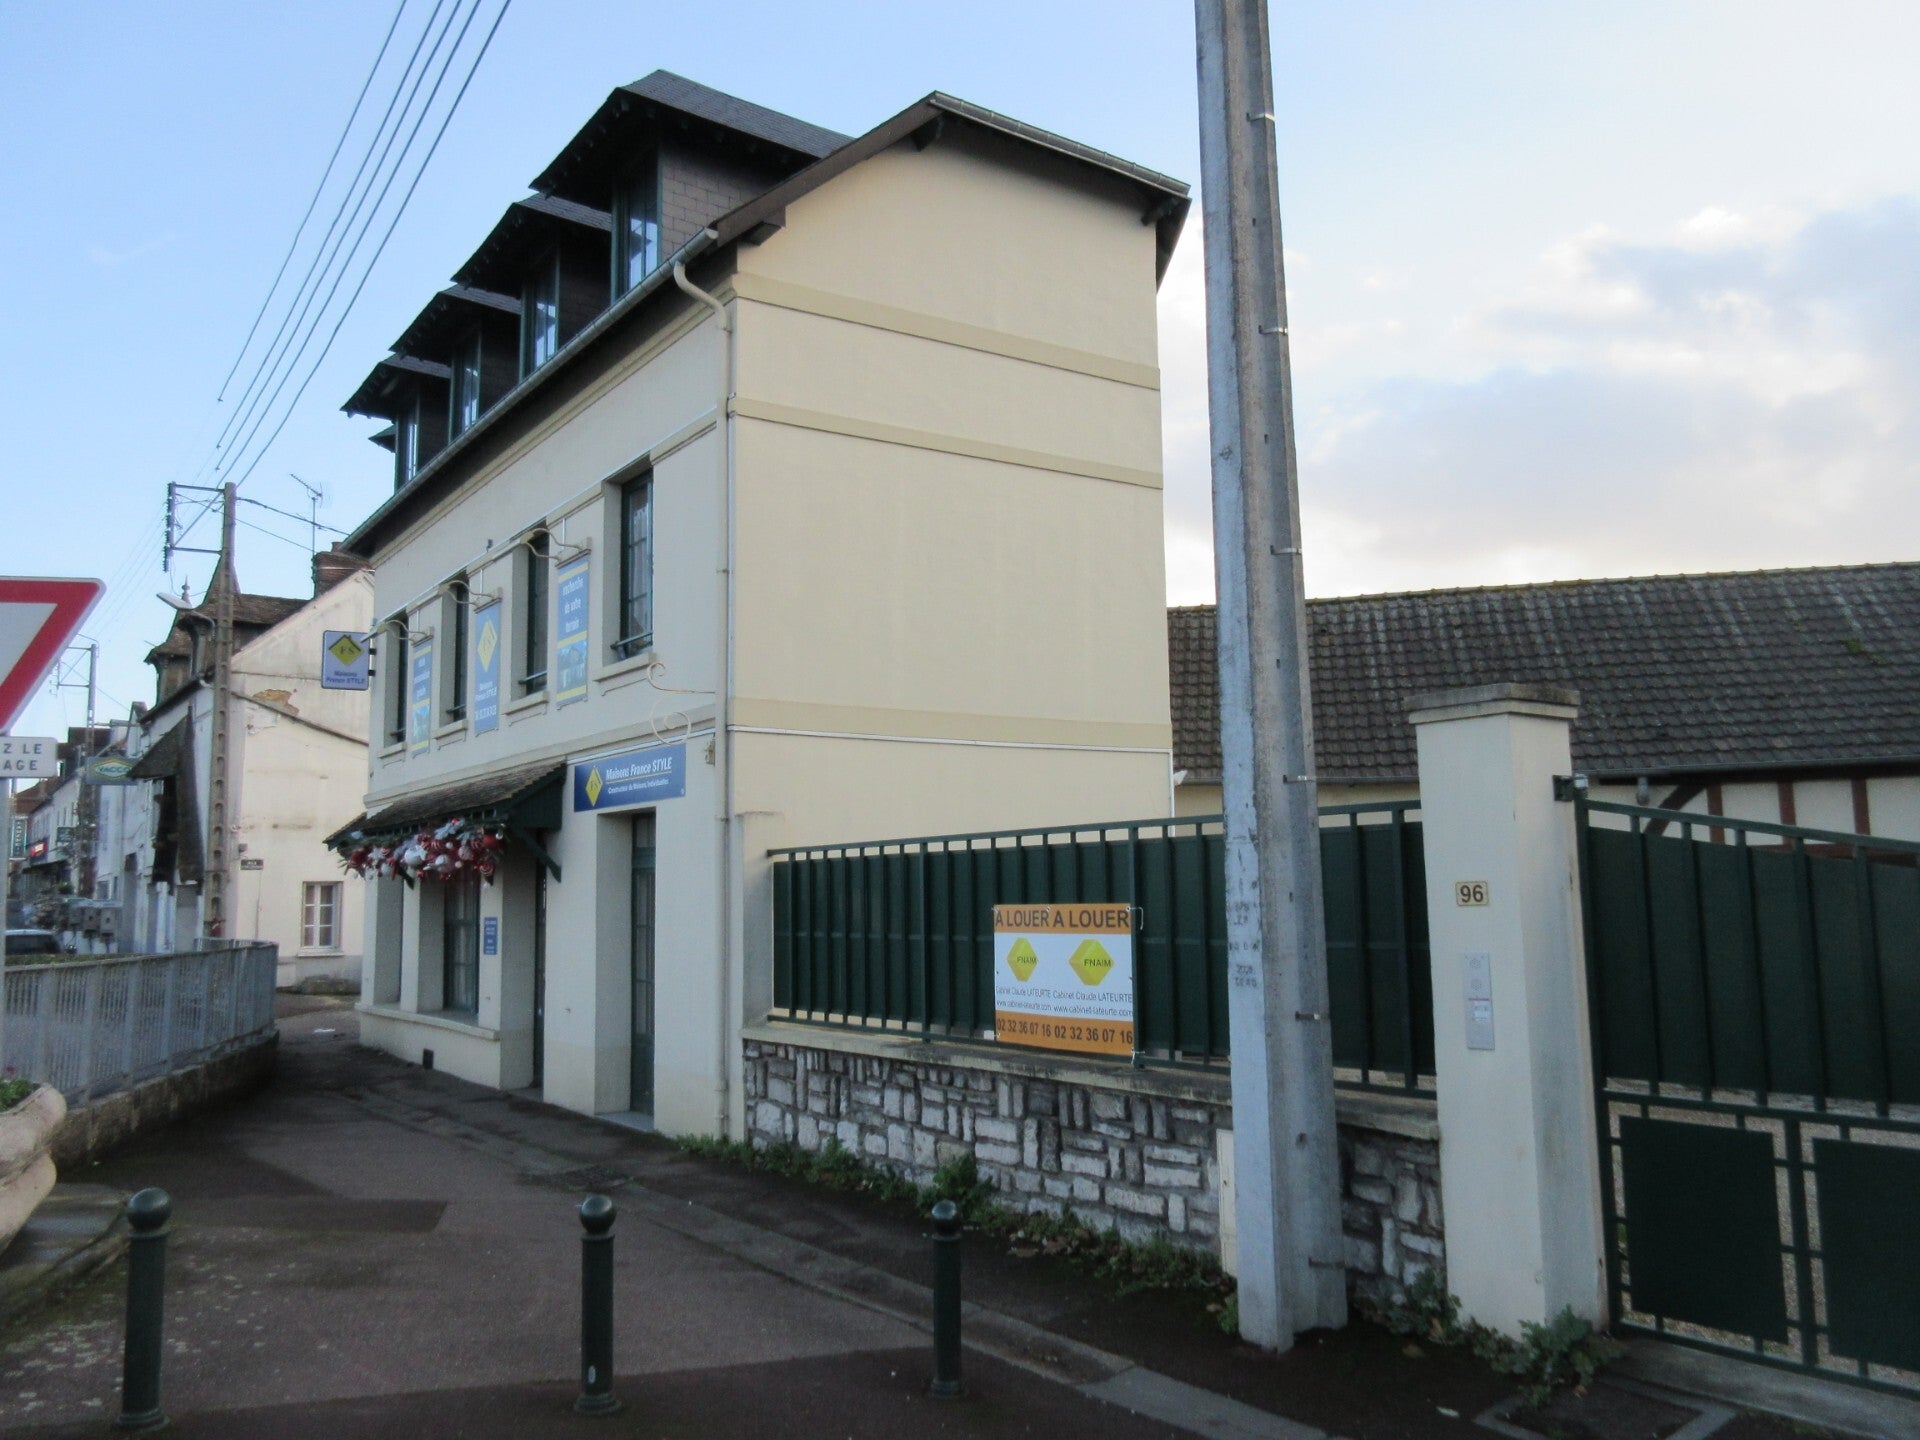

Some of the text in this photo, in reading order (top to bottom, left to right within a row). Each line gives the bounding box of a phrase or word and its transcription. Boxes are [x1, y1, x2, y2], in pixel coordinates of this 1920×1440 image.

[22, 743, 42, 755] LE
[631, 764, 652, 776] France
[653, 757, 672, 772] STYLE
[1460, 884, 1484, 904] 96
[995, 909, 1129, 928] A LOUER A LOUER
[1083, 958, 1112, 968] FNAIM
[1007, 1019, 1017, 1033] 32
[1018, 1021, 1028, 1034] 36
[1029, 1021, 1039, 1035] 07
[1042, 1023, 1051, 1037] 16
[1054, 1024, 1134, 1045] 02 32 36 07 16
